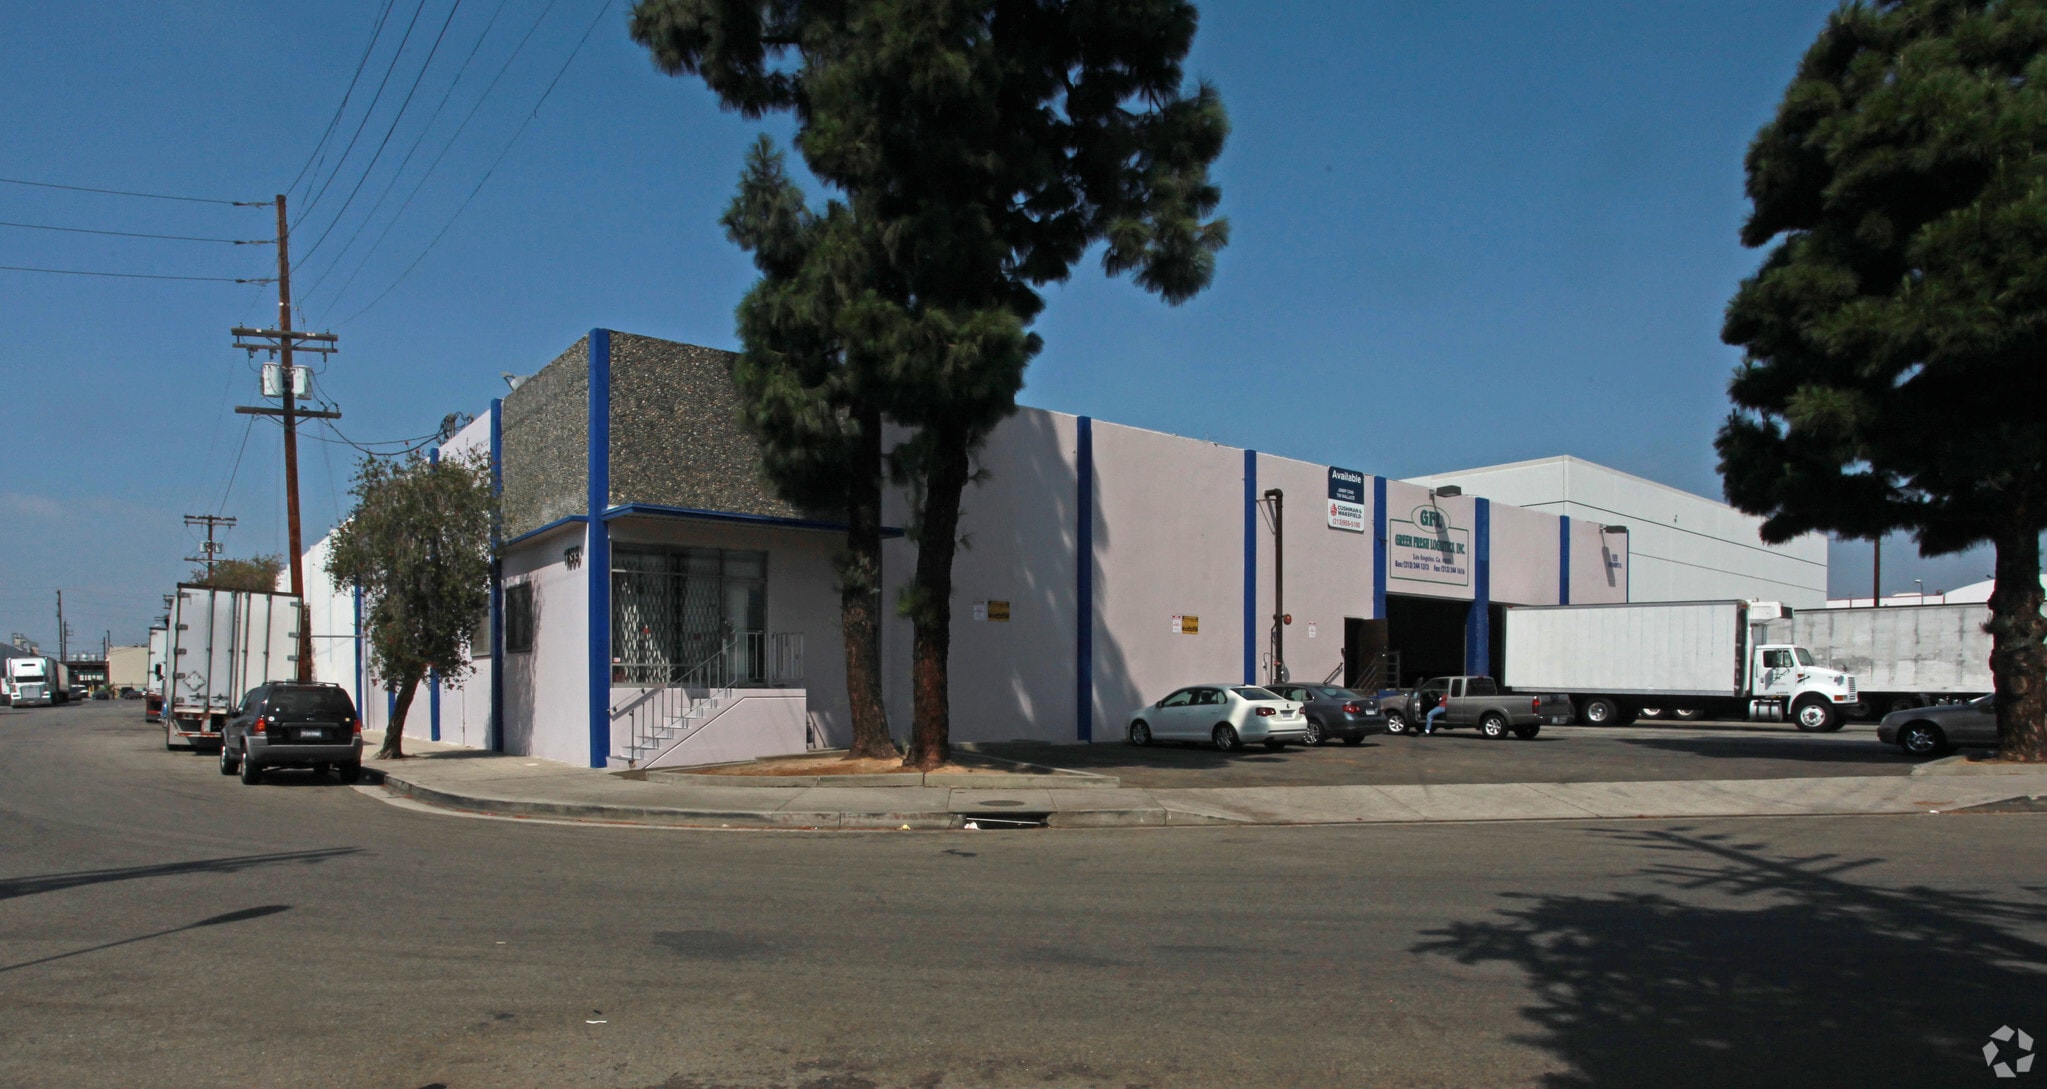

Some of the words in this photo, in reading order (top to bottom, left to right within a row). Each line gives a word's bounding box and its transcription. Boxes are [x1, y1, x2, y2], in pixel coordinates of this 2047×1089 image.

[1332, 470, 1361, 483] Available
[1338, 505, 1357, 513] CUSHMAN
[1420, 510, 1443, 529] GFL
[1395, 534, 1413, 548] GREEN
[1413, 536, 1430, 550] FRESH
